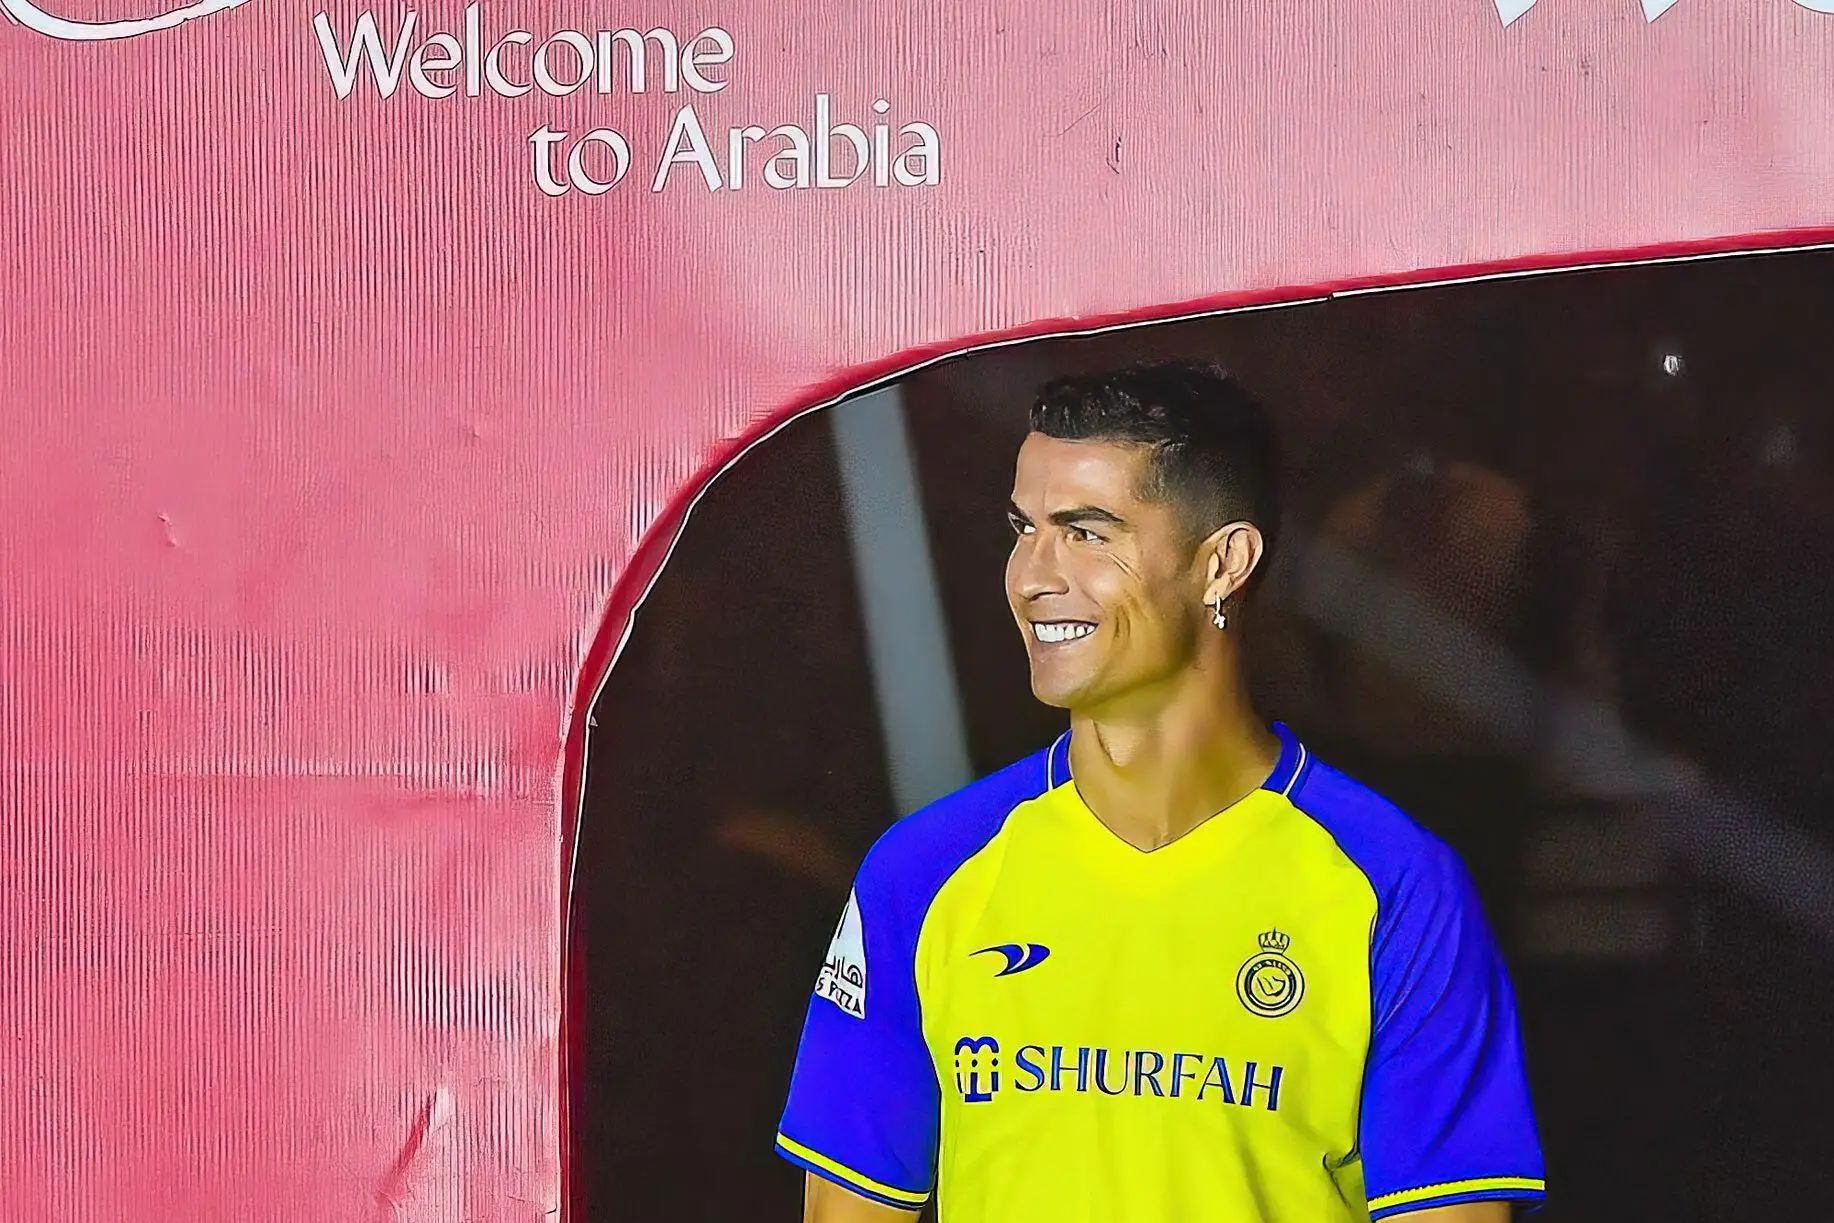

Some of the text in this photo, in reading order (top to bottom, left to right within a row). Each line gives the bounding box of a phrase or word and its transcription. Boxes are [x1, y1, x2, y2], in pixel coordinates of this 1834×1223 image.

[312, 1, 735, 101] Welcome
[528, 93, 941, 196] to Arabia
[1014, 1045, 1284, 1111] SHURFAH
